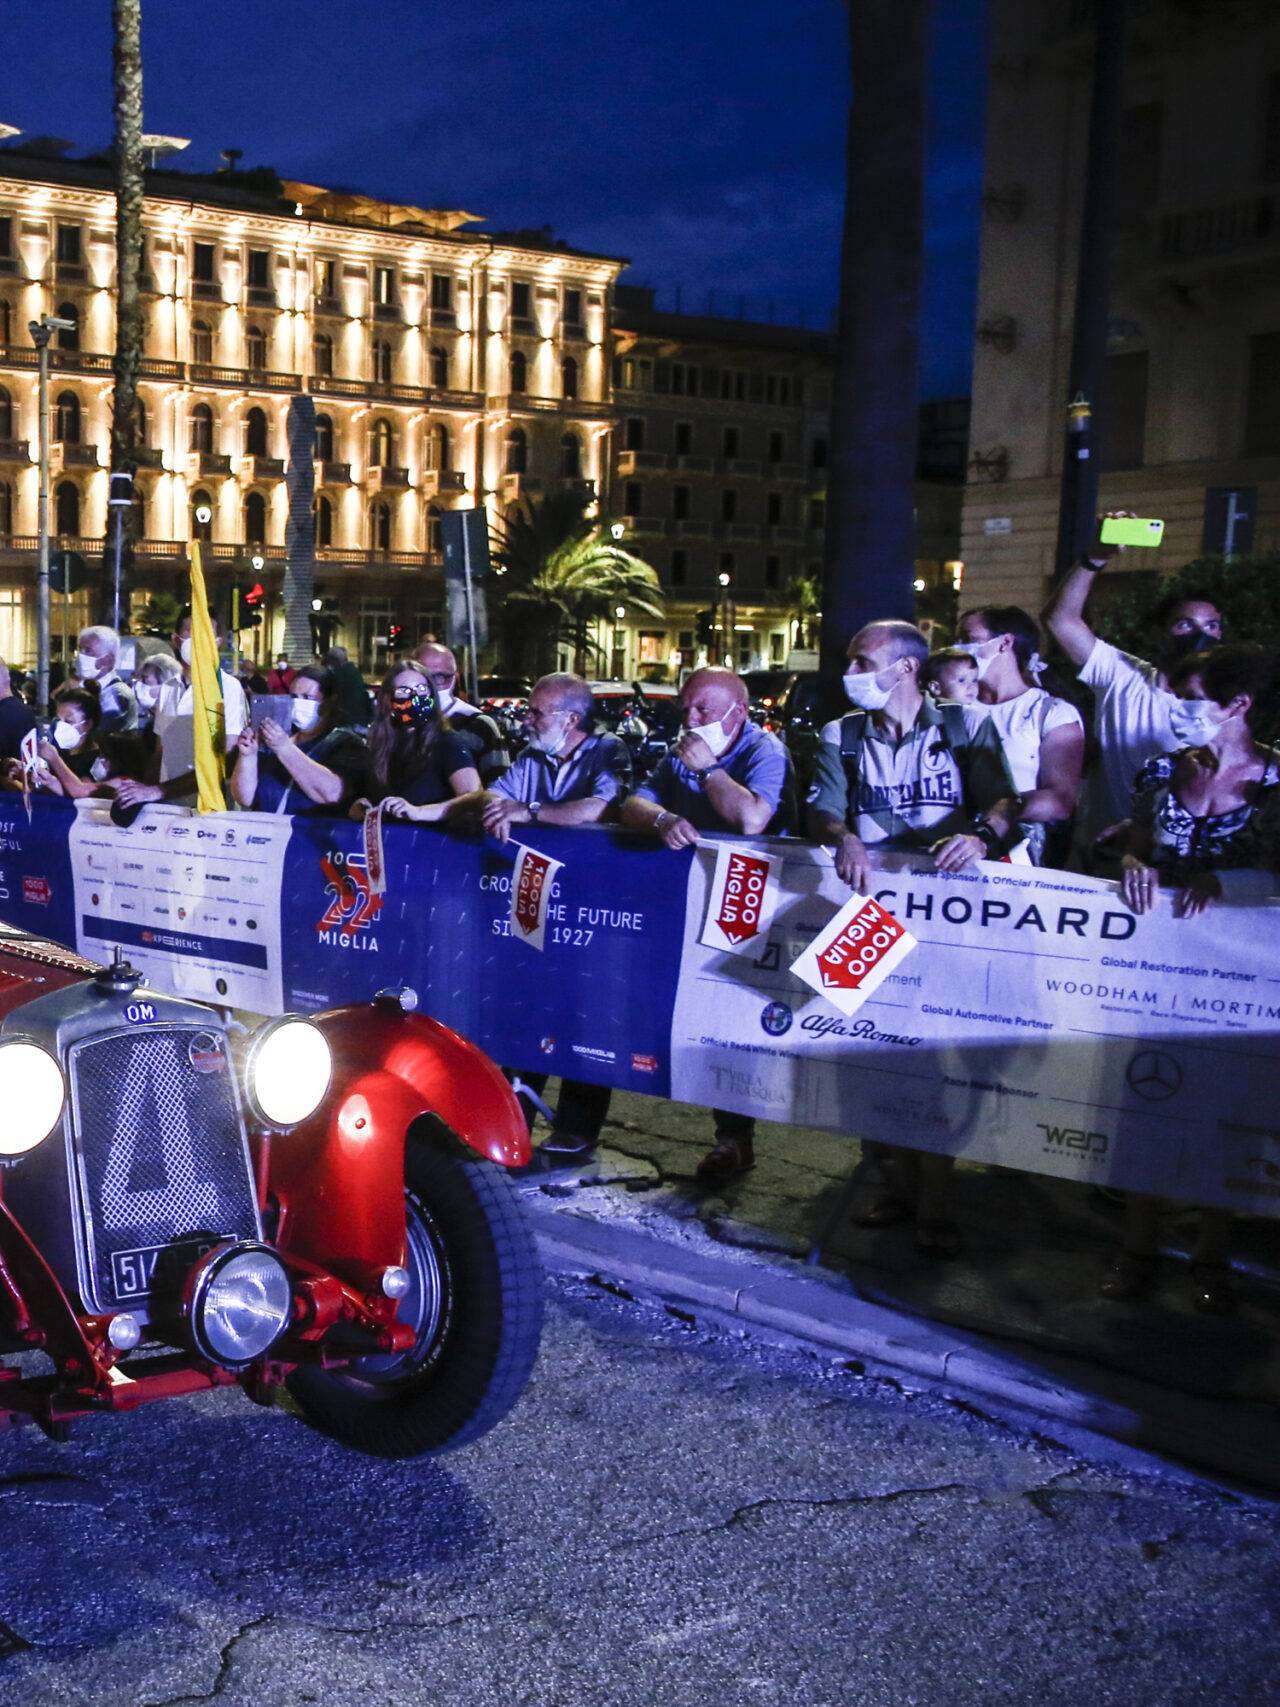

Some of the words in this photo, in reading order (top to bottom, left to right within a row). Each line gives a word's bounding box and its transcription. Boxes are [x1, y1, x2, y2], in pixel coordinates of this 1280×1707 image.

[529, 866, 544, 917] 1000
[722, 858, 747, 922] MIGLIA
[940, 870, 979, 883] Sponsor
[992, 875, 1031, 888] Official
[742, 868, 763, 924] 1000
[578, 907, 643, 930] FUTURE
[875, 889, 1137, 940] CHOPARD
[318, 930, 379, 952] MIGLIA
[552, 927, 594, 946] 1927
[824, 904, 882, 965] MIGLIA
[848, 925, 898, 976] 1000
[1101, 956, 1137, 969] Global
[1140, 960, 1209, 977] Restoration
[1211, 968, 1257, 983] Partner
[1046, 979, 1158, 1004] WOODHAM
[126, 1003, 155, 1021] OM
[921, 1004, 953, 1016] Global
[955, 1008, 1012, 1024] Automotive
[1015, 1016, 1054, 1030] Partner
[700, 1036, 728, 1048] Official
[800, 1014, 848, 1039] Alfa
[850, 1019, 923, 1046] Romeo
[996, 1083, 1040, 1098] Sponsor
